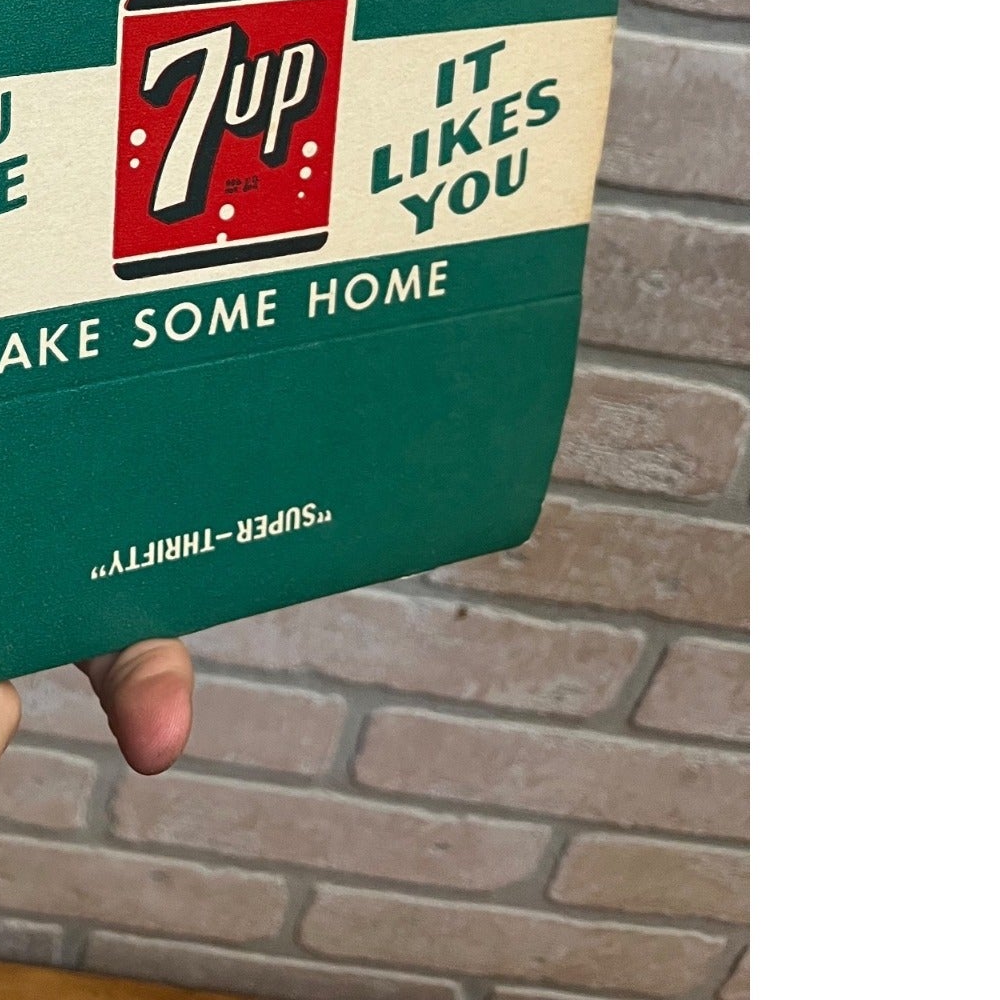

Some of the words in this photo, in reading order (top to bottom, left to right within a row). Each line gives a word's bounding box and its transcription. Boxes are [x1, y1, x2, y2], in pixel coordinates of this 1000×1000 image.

[436, 40, 506, 109] IT
[370, 77, 561, 194] LIKES
[400, 148, 528, 235] YOU
[134, 288, 277, 348] SOME
[308, 260, 449, 318] HOME
